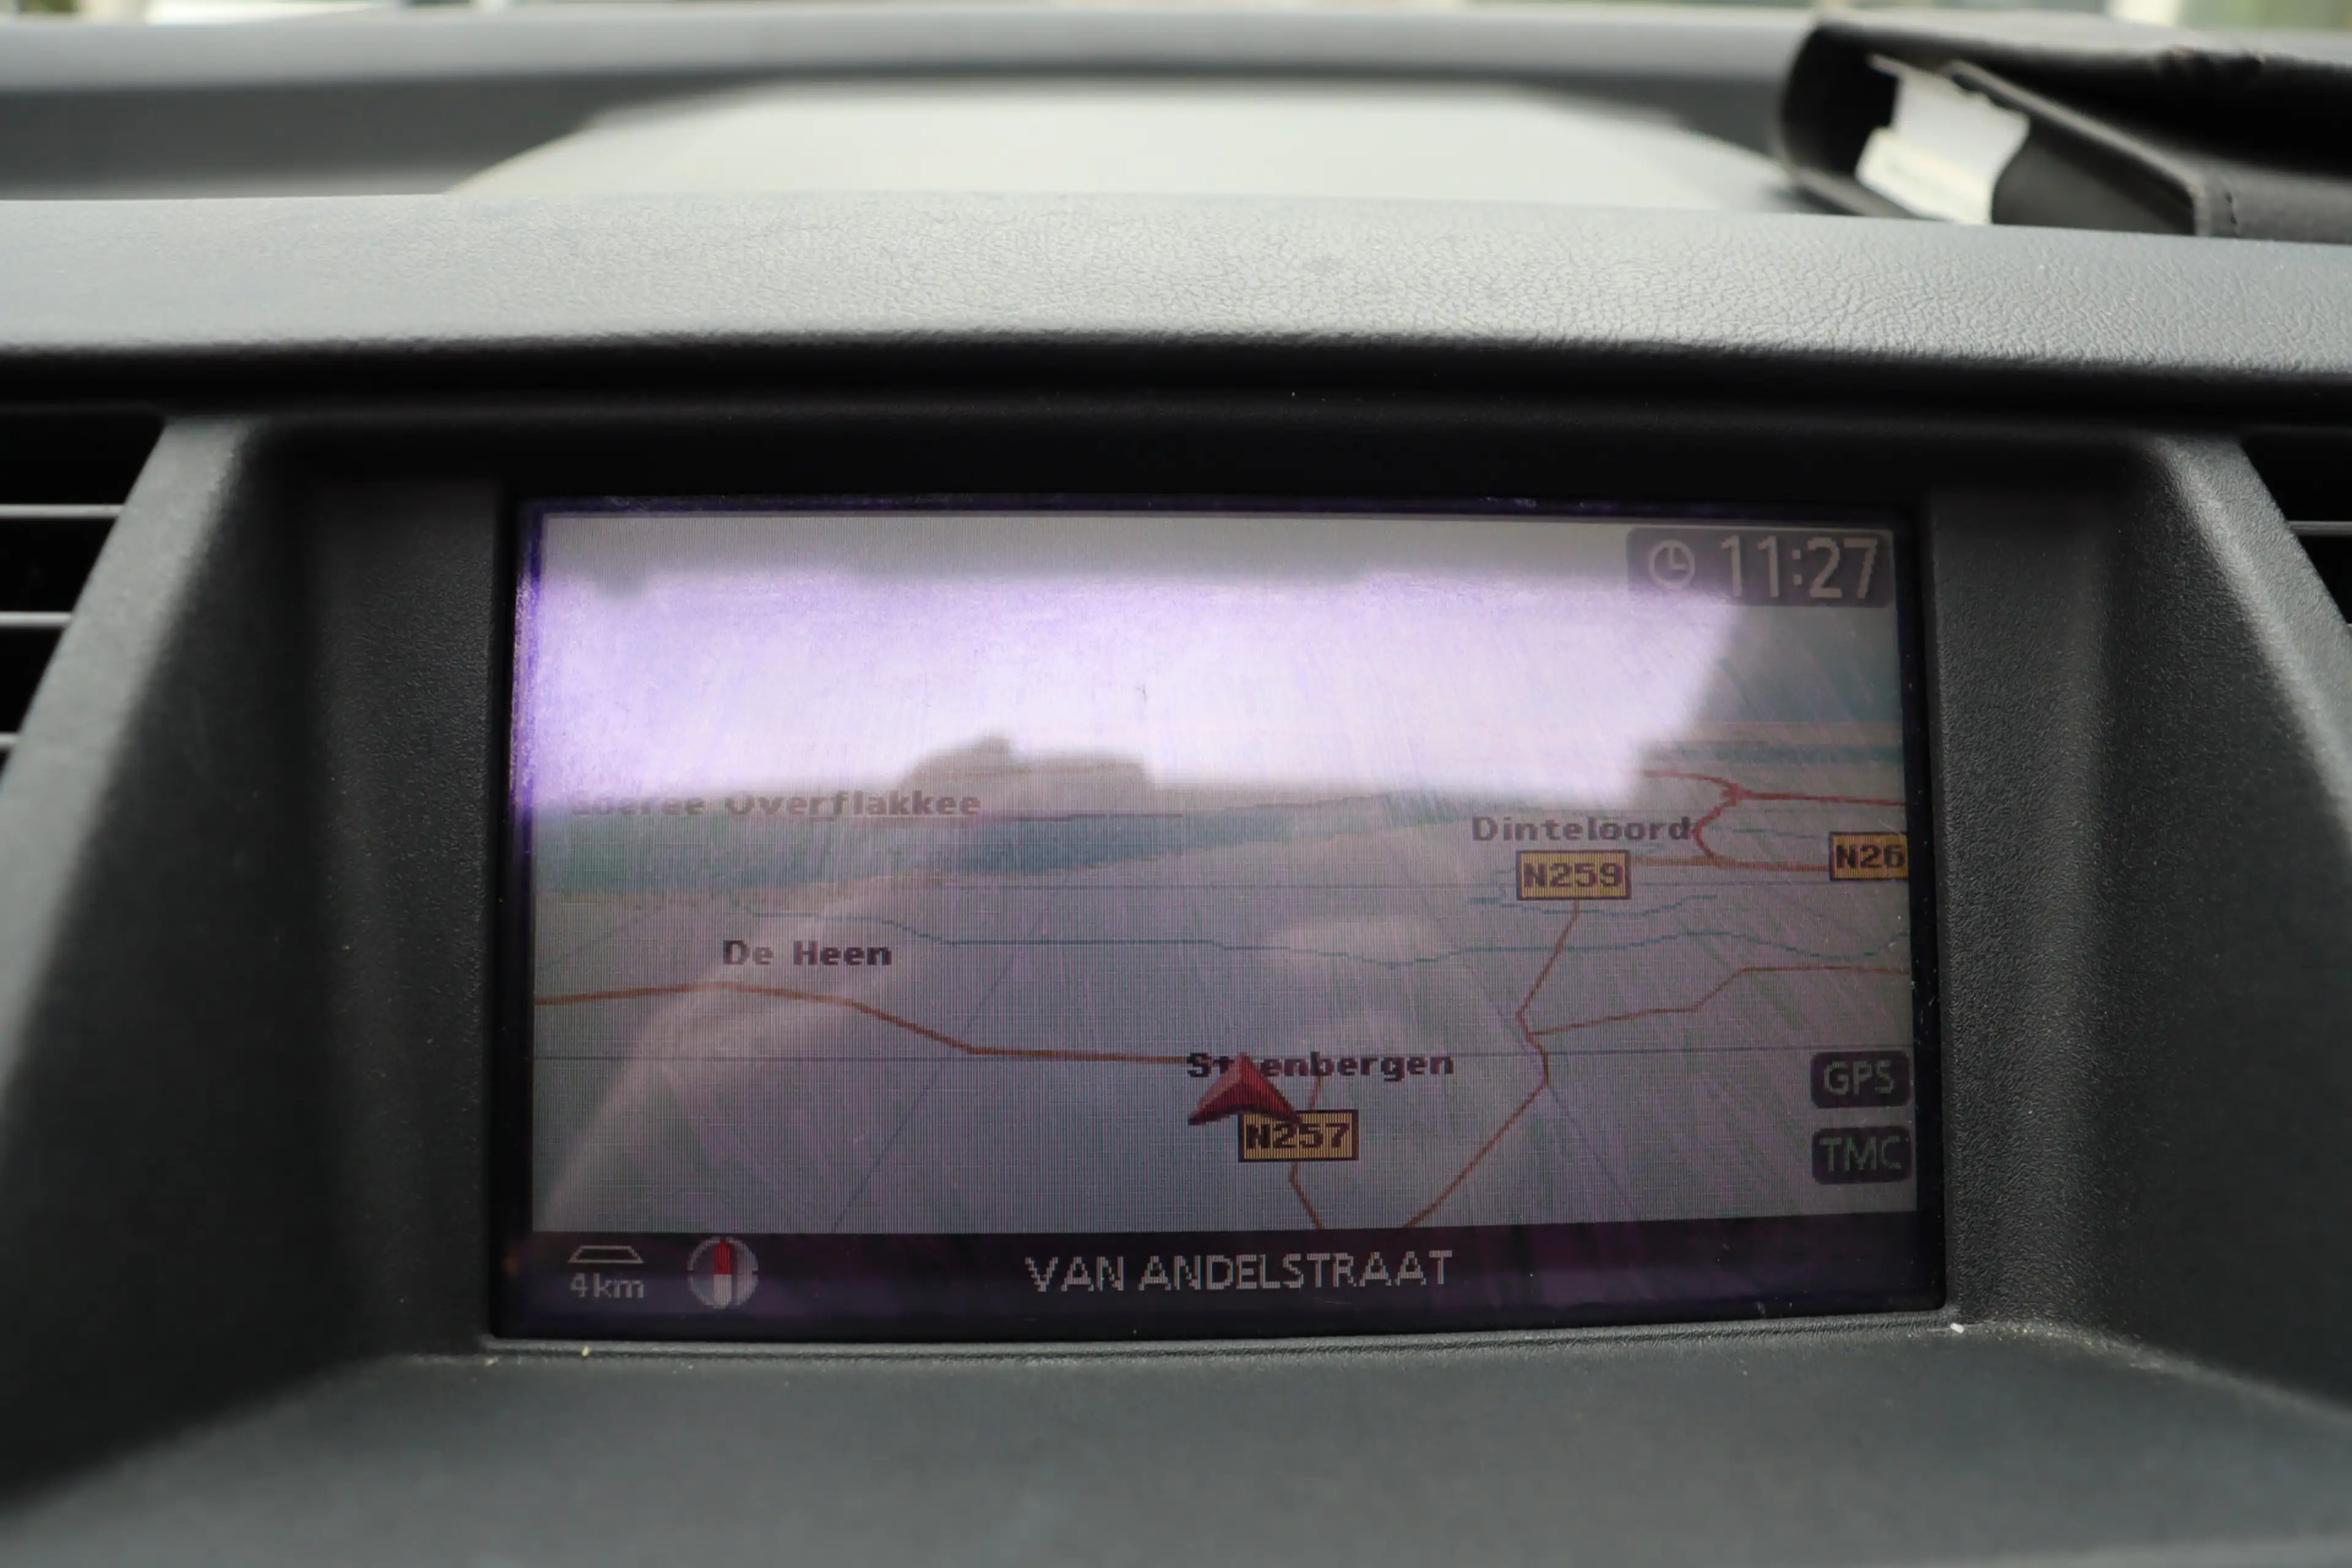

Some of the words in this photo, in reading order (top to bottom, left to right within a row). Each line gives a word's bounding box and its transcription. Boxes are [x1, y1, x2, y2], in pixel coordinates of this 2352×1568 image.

[1721, 534, 1879, 600] 11:27
[1472, 816, 1691, 842] Dinteloord
[1523, 862, 1625, 888] N259
[723, 940, 774, 965] De
[793, 940, 892, 966] Heen
[1186, 1051, 1455, 1082] Stenbergen
[1823, 1060, 1894, 1096] GPS
[1246, 1122, 1351, 1150] N257
[1819, 1135, 1901, 1172] TMC
[1025, 1256, 1124, 1292] VAN
[1138, 1250, 1453, 1291] ANDELSTRAAT
